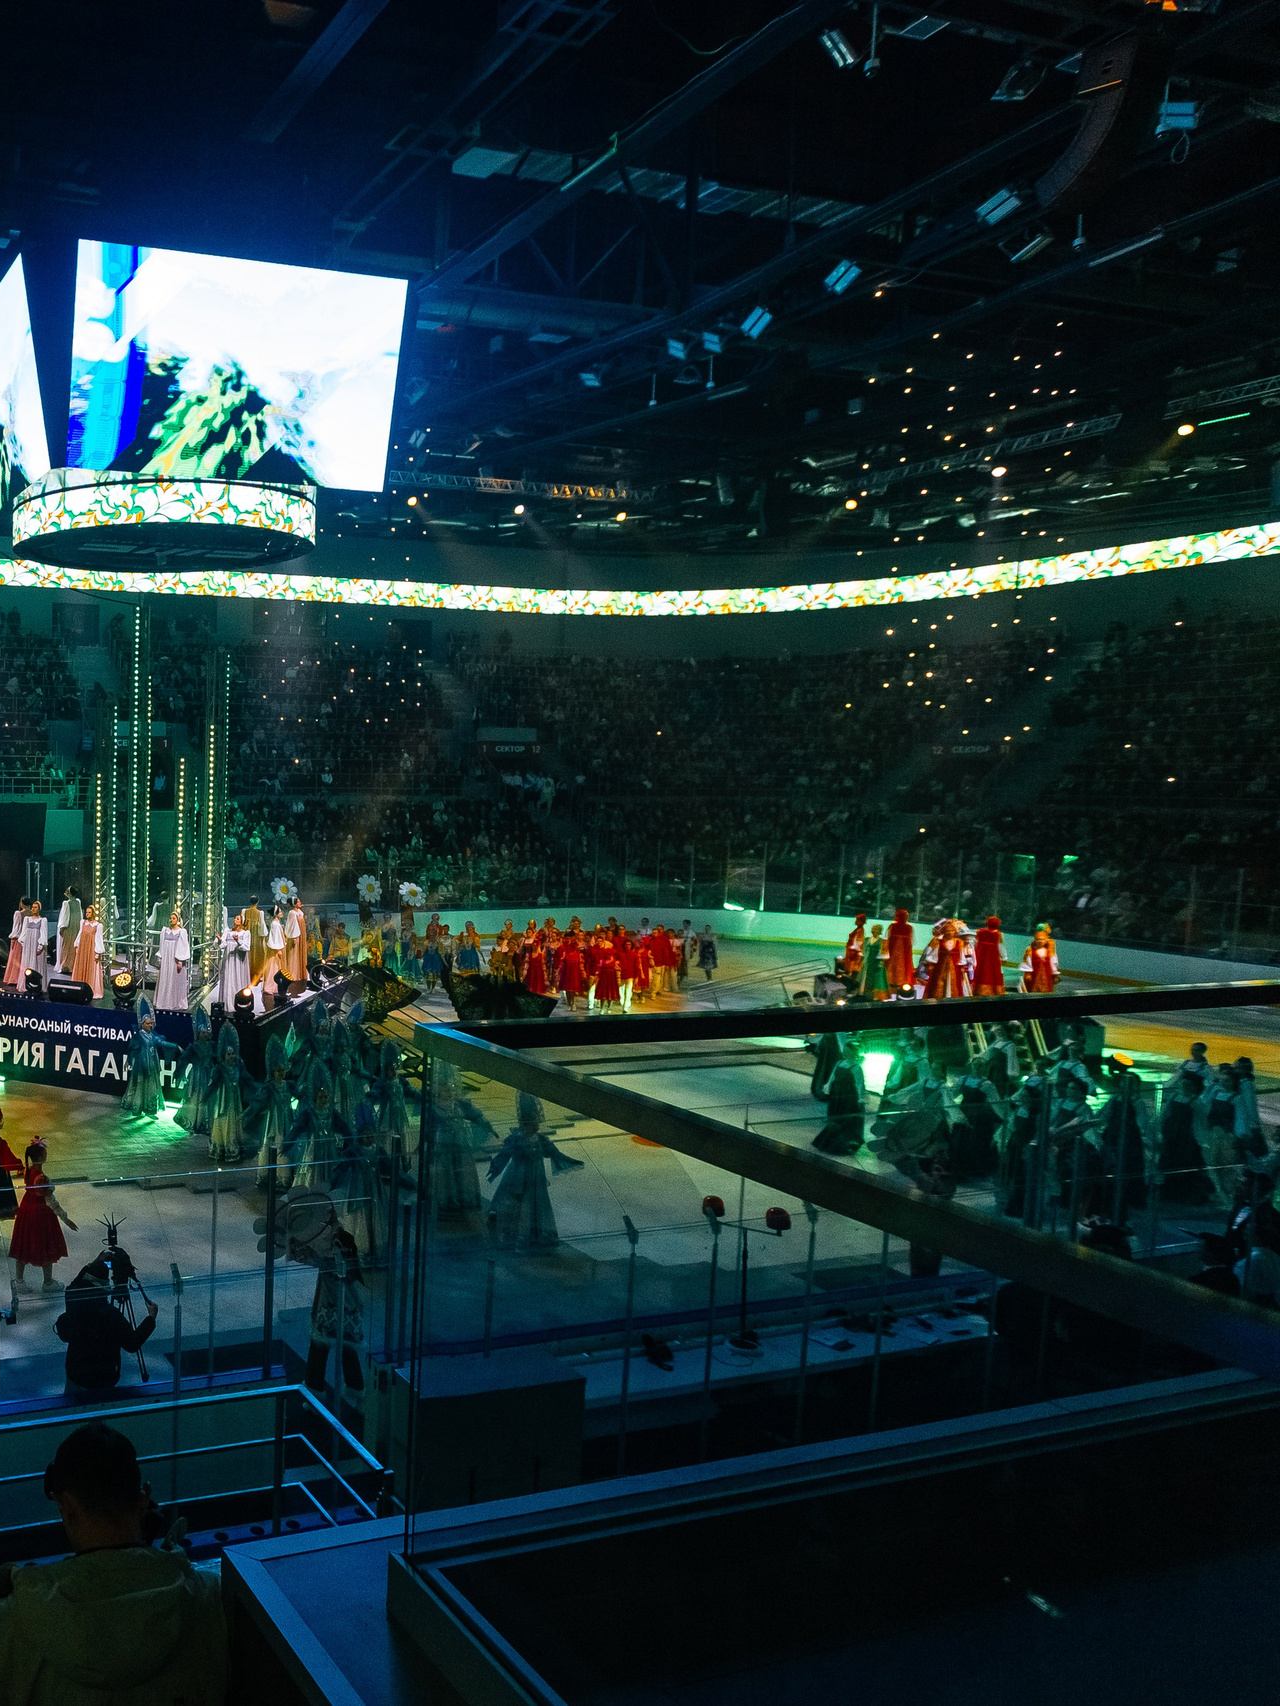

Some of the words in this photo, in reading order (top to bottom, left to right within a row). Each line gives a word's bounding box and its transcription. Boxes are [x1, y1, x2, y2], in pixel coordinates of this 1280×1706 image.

[495, 745, 526, 753] СЕКТОР
[532, 745, 541, 753] 12
[74, 1024, 136, 1042] ФЕСТИВАЛ
